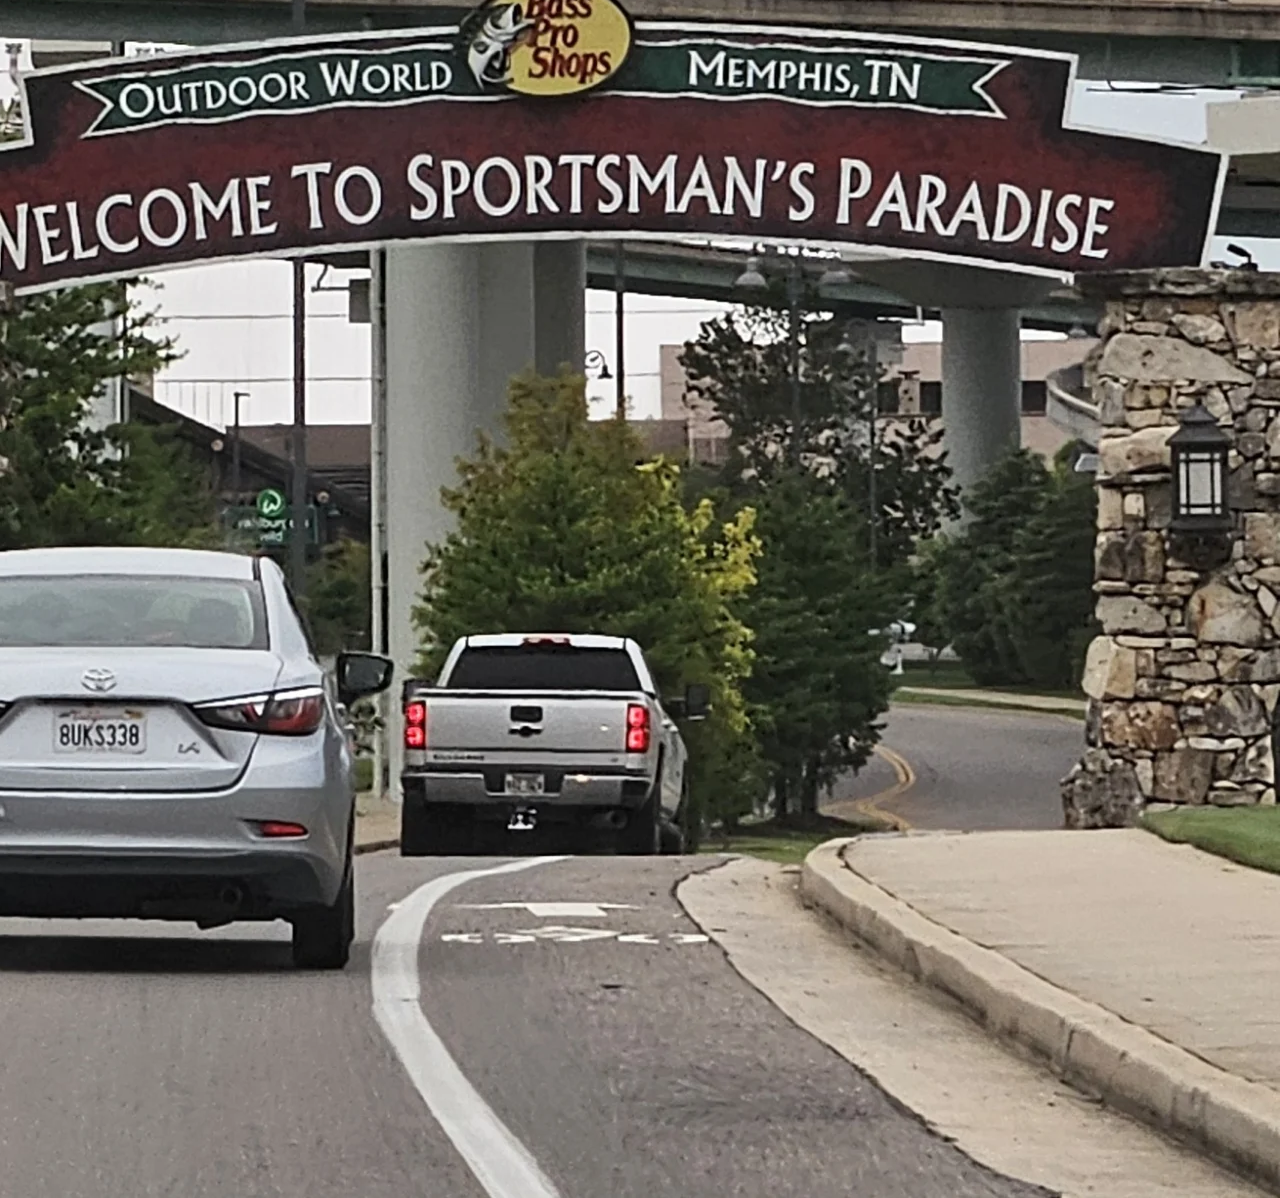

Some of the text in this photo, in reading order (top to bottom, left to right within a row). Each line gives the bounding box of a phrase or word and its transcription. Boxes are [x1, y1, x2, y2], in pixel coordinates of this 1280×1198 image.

[526, 18, 579, 48] Pro
[528, 46, 612, 84] Shops
[119, 59, 452, 119] OUTDOOR WORLD
[291, 162, 382, 229] TO
[835, 156, 1115, 259] PARADISE
[59, 724, 140, 747] 8UKS338
